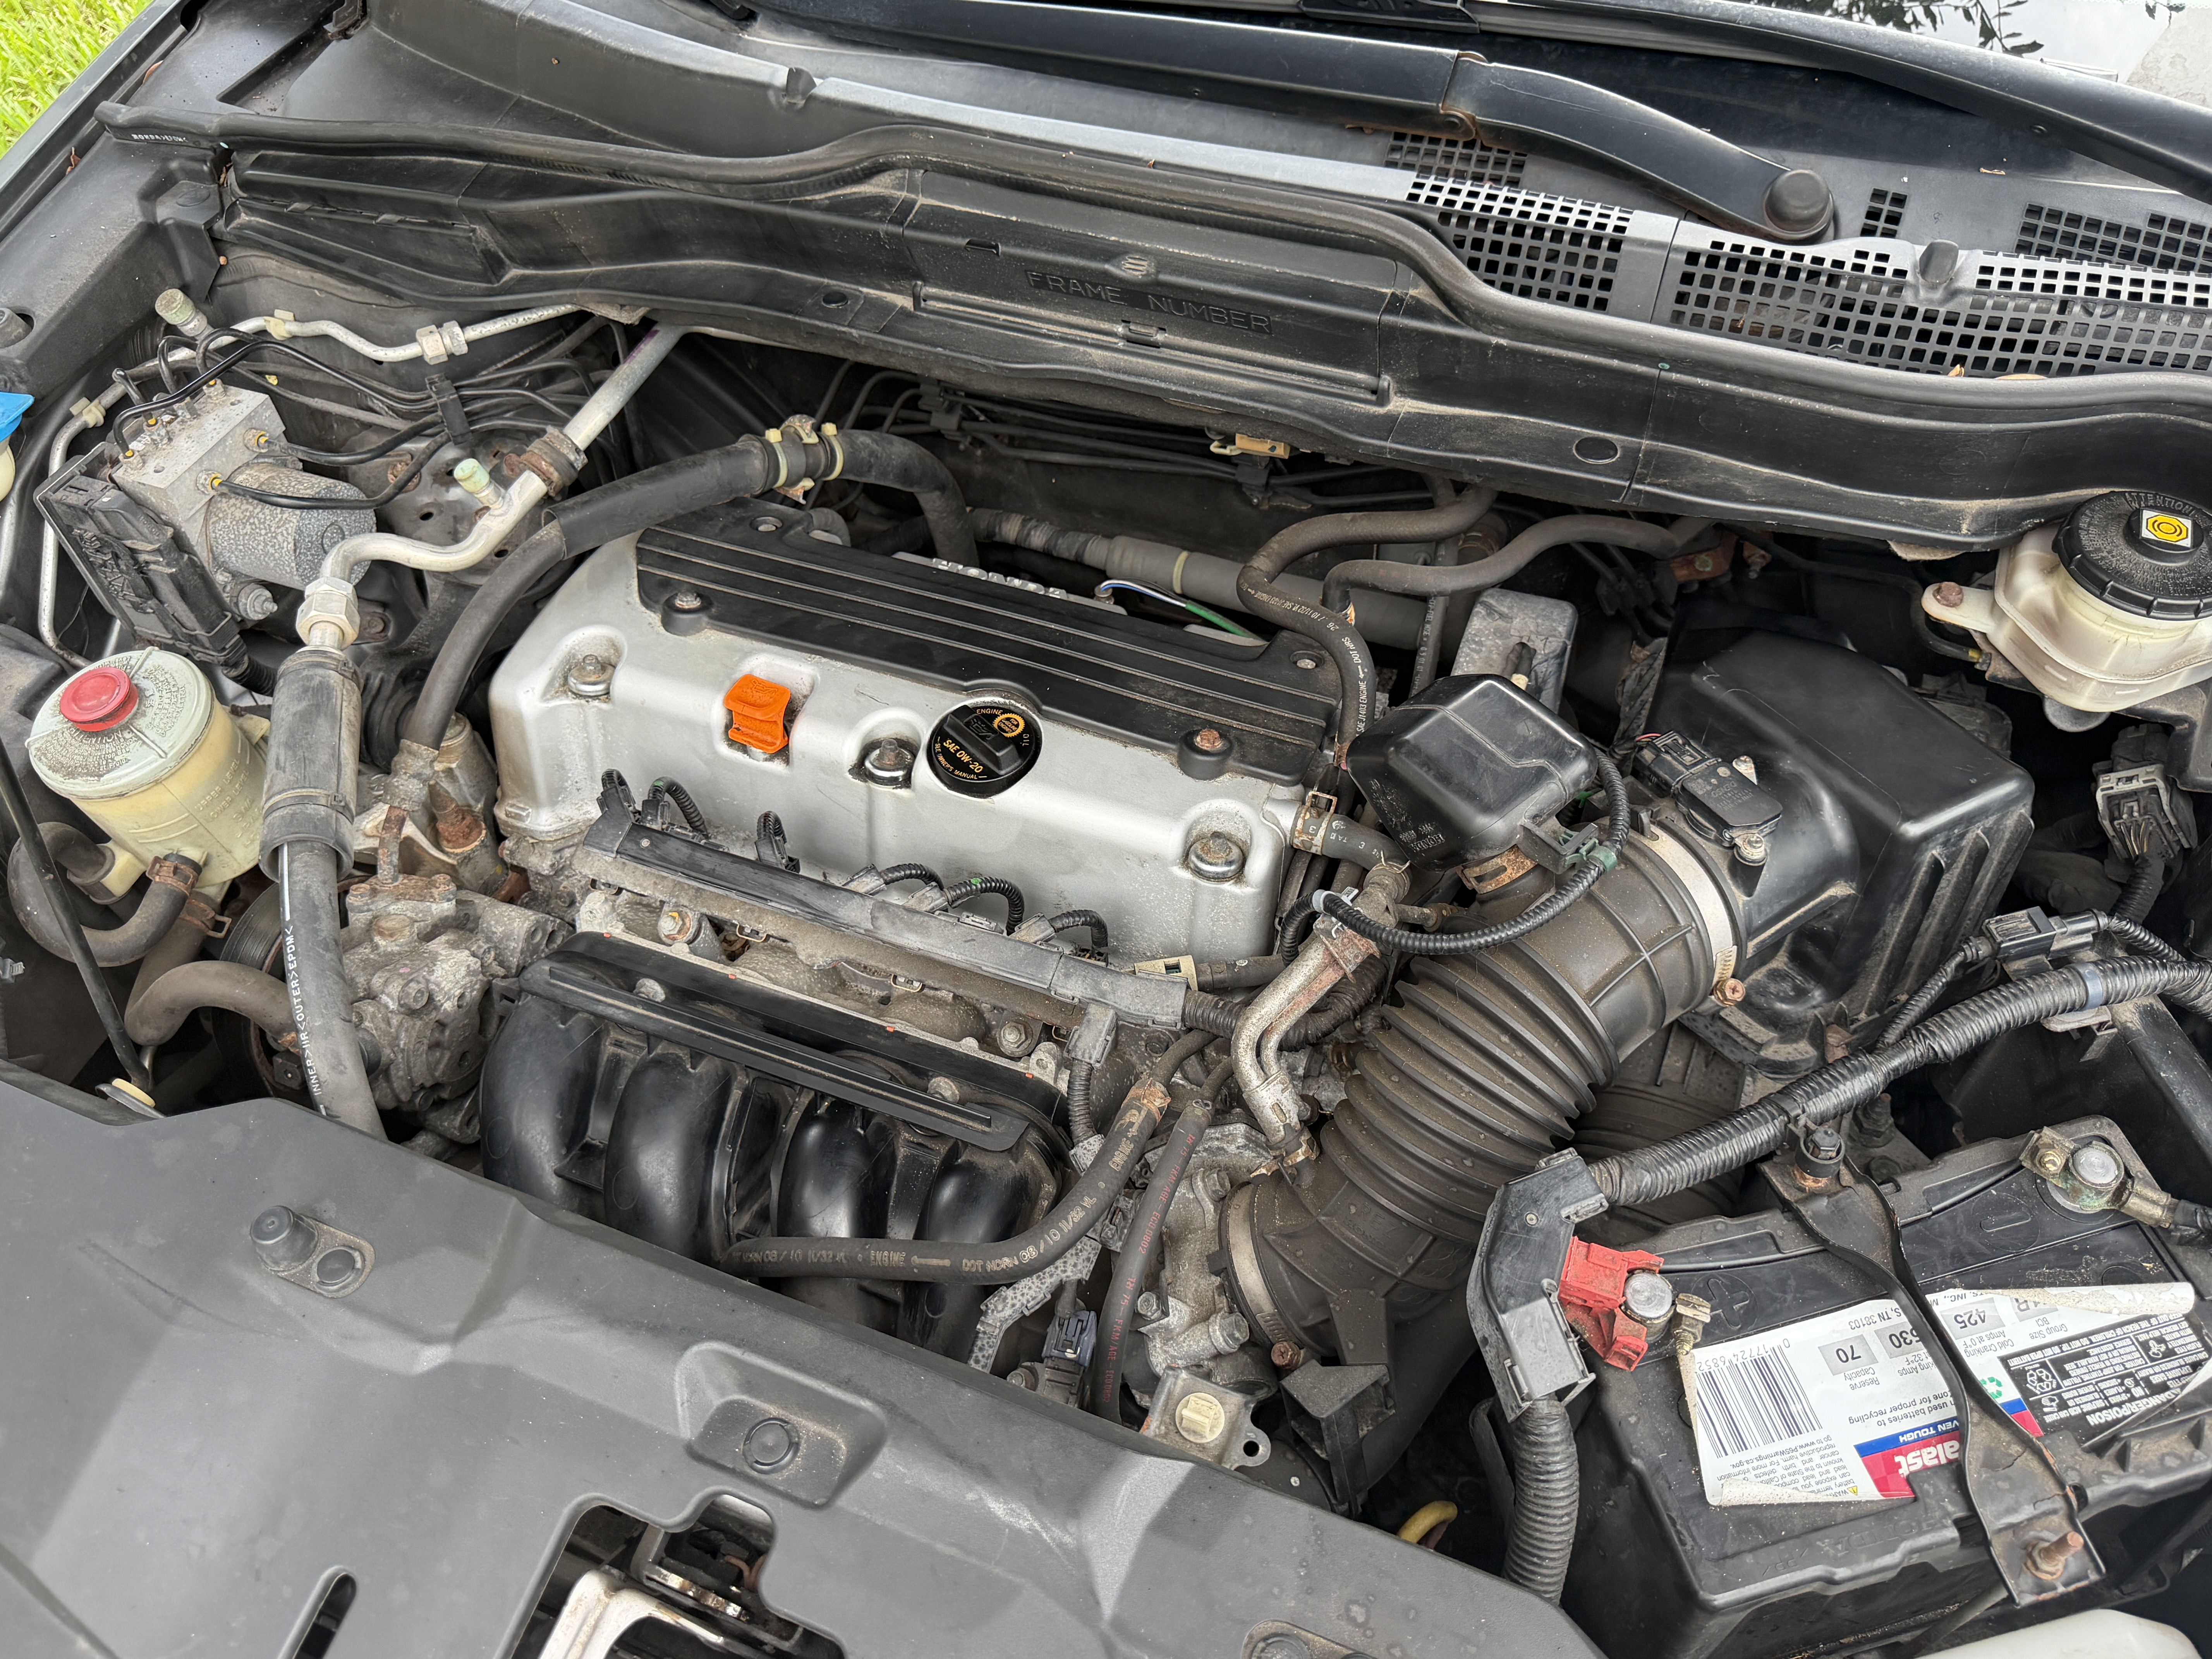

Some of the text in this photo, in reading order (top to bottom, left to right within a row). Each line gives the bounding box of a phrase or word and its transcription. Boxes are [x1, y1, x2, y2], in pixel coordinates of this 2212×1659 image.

[1024, 271, 1275, 334] FRAME NUMBER
[1349, 649, 1362, 664] DOT
[1357, 680, 1369, 703] ENGINE
[1356, 721, 1365, 732] SAE
[943, 740, 983, 772] SAE 0W-20
[954, 770, 977, 779] MANUAL
[194, 757, 242, 815] UPPER LEVEL
[230, 769, 252, 796] LEVEL
[1158, 1163, 1181, 1204] FKM/AGE
[870, 1250, 906, 1267] ENGINE
[961, 1256, 984, 1274] DOT
[1018, 1245, 1039, 1263] 08
[1044, 1228, 1062, 1245] 10
[1055, 1204, 1089, 1234] 11/32
[1107, 1136, 1136, 1172] ENGINE
[1848, 1314, 1877, 1330] 38103
[1876, 1310, 1892, 1322] TN
[1952, 1306, 1989, 1330] 425
[2035, 1316, 2049, 1327] BCI
[2138, 1319, 2150, 1328] THE
[2149, 1317, 2159, 1326] OF
[2156, 1314, 2169, 1323] OUT
[1984, 1328, 2006, 1342] Amps
[2028, 1322, 2068, 1341] Group Size
[2122, 1322, 2140, 1333] REACH
[1107, 1318, 1123, 1361] FKM/AGE
[1976, 1335, 1985, 1344] at
[2069, 1339, 2081, 1348] NOT
[1695, 1338, 1790, 1371] 0 17724 6852
[1834, 1343, 1861, 1364] 70
[1964, 1338, 2014, 1360] Cold Cranking
[2030, 1350, 2044, 1360] OPEN
[2042, 1347, 2054, 1356] NOT
[2051, 1345, 2061, 1353] DO
[1903, 1353, 1923, 1365] 32°F
[1842, 1365, 1875, 1382] Capacity
[1897, 1364, 1918, 1378] Amps
[1849, 1376, 1880, 1392] Reserve
[2130, 1386, 2145, 1398] NO
[1847, 1395, 1931, 1426] for proper recycling
[1876, 1401, 1948, 1428] used batteries to
[2085, 1390, 2175, 1424] DANGER/POISON
[1822, 1434, 1832, 1443] go
[1898, 1419, 1959, 1443] VEN TOUGH
[1729, 1439, 1815, 1470] www.P65Warnings.ca.gov.
[1798, 1442, 1836, 1458] reproductive
[1753, 1449, 1839, 1480] cancer and birth defects
[1780, 1453, 1798, 1463] harm.
[1822, 1457, 1843, 1468] known
[1892, 1438, 1965, 1478] alast
[1717, 1467, 1751, 1482] information
[1751, 1463, 1767, 1472] more
[1786, 1468, 1804, 1479] State
[1802, 1464, 1847, 1482] lead and lead
[1803, 1465, 1815, 1473] the
[1800, 1480, 1813, 1489] you
[1814, 1474, 1837, 1486] expose
[1834, 1477, 1854, 1489] battery
